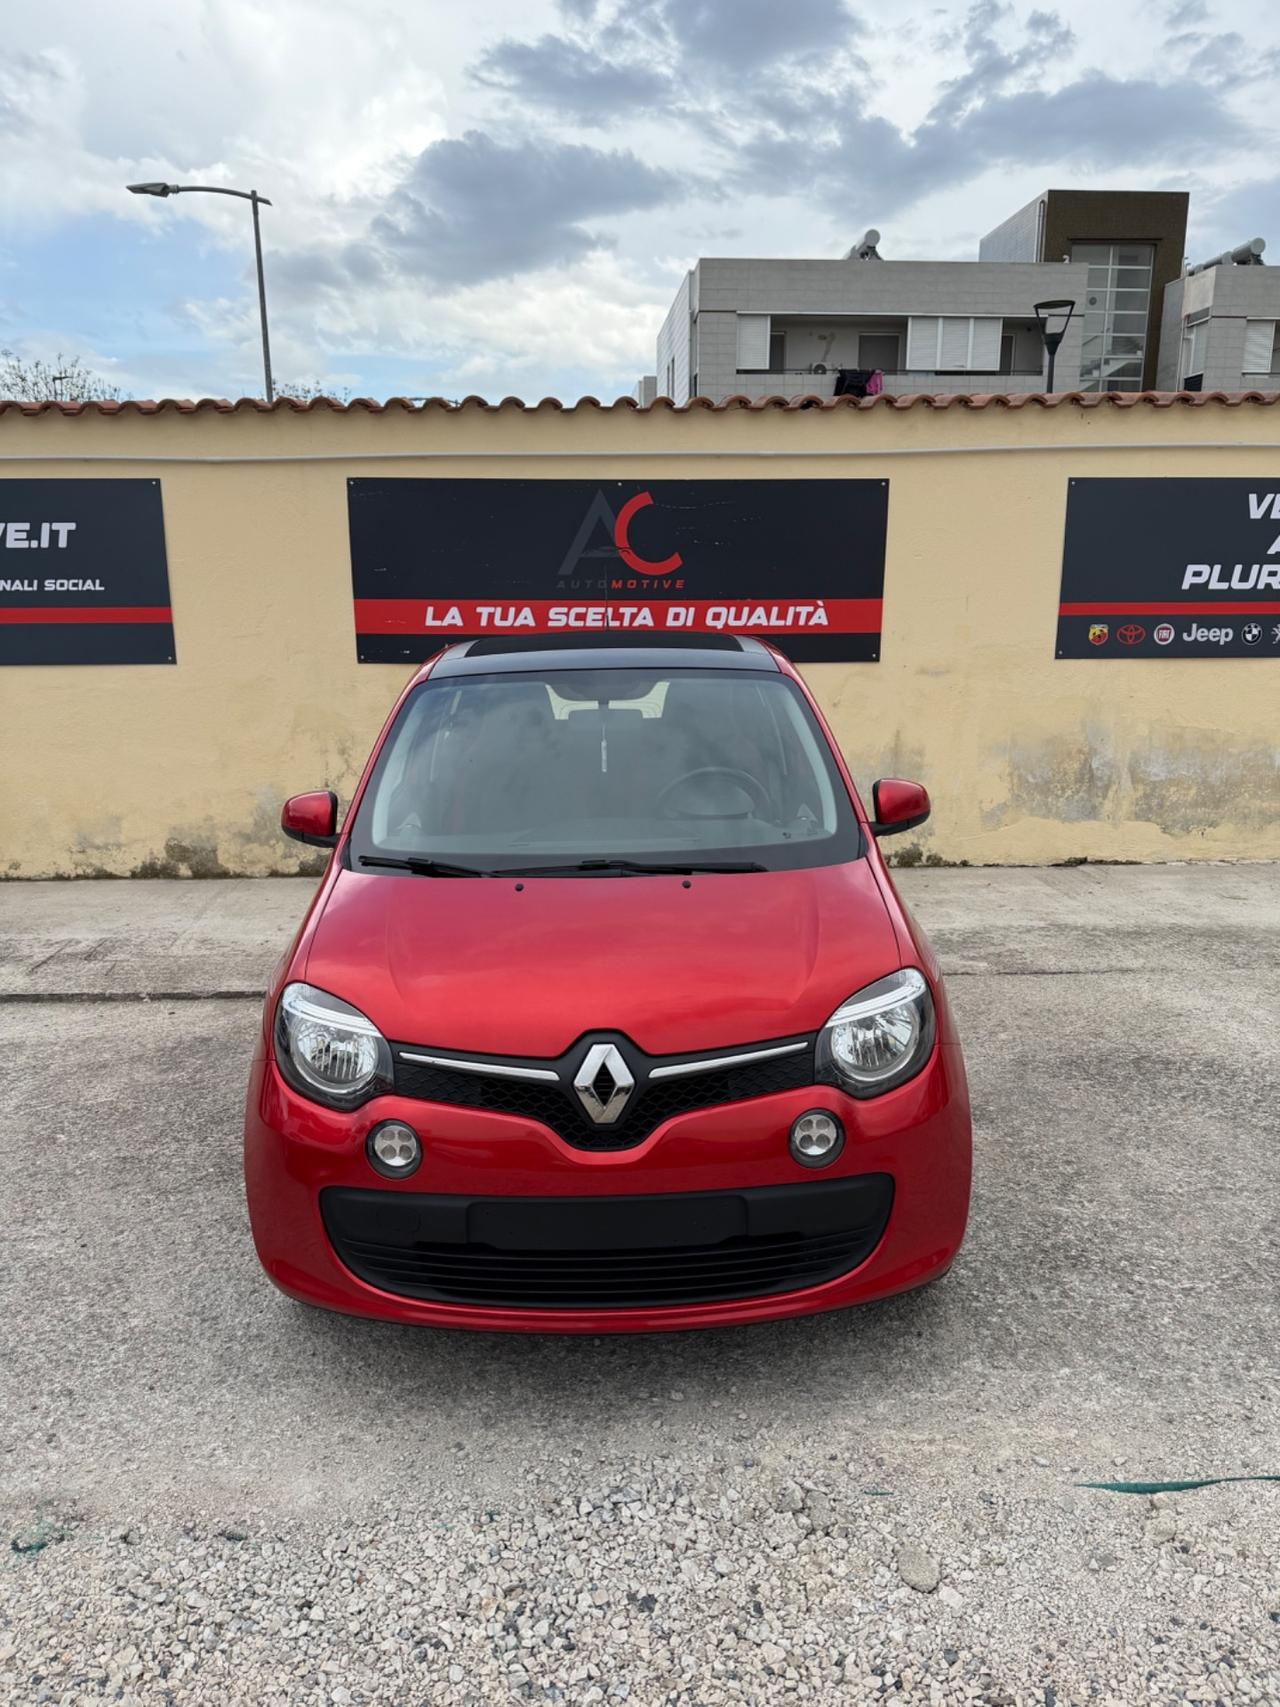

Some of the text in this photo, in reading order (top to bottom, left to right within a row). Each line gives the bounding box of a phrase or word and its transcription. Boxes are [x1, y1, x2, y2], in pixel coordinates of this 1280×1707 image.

[0, 522, 76, 548] E.IT
[44, 579, 105, 591] SOCIAL
[556, 579, 686, 589] AUTOMOTIVE
[425, 600, 829, 629] LA TUA SCELTA DI QUALITÀ
[1182, 623, 1234, 645] Jeep
